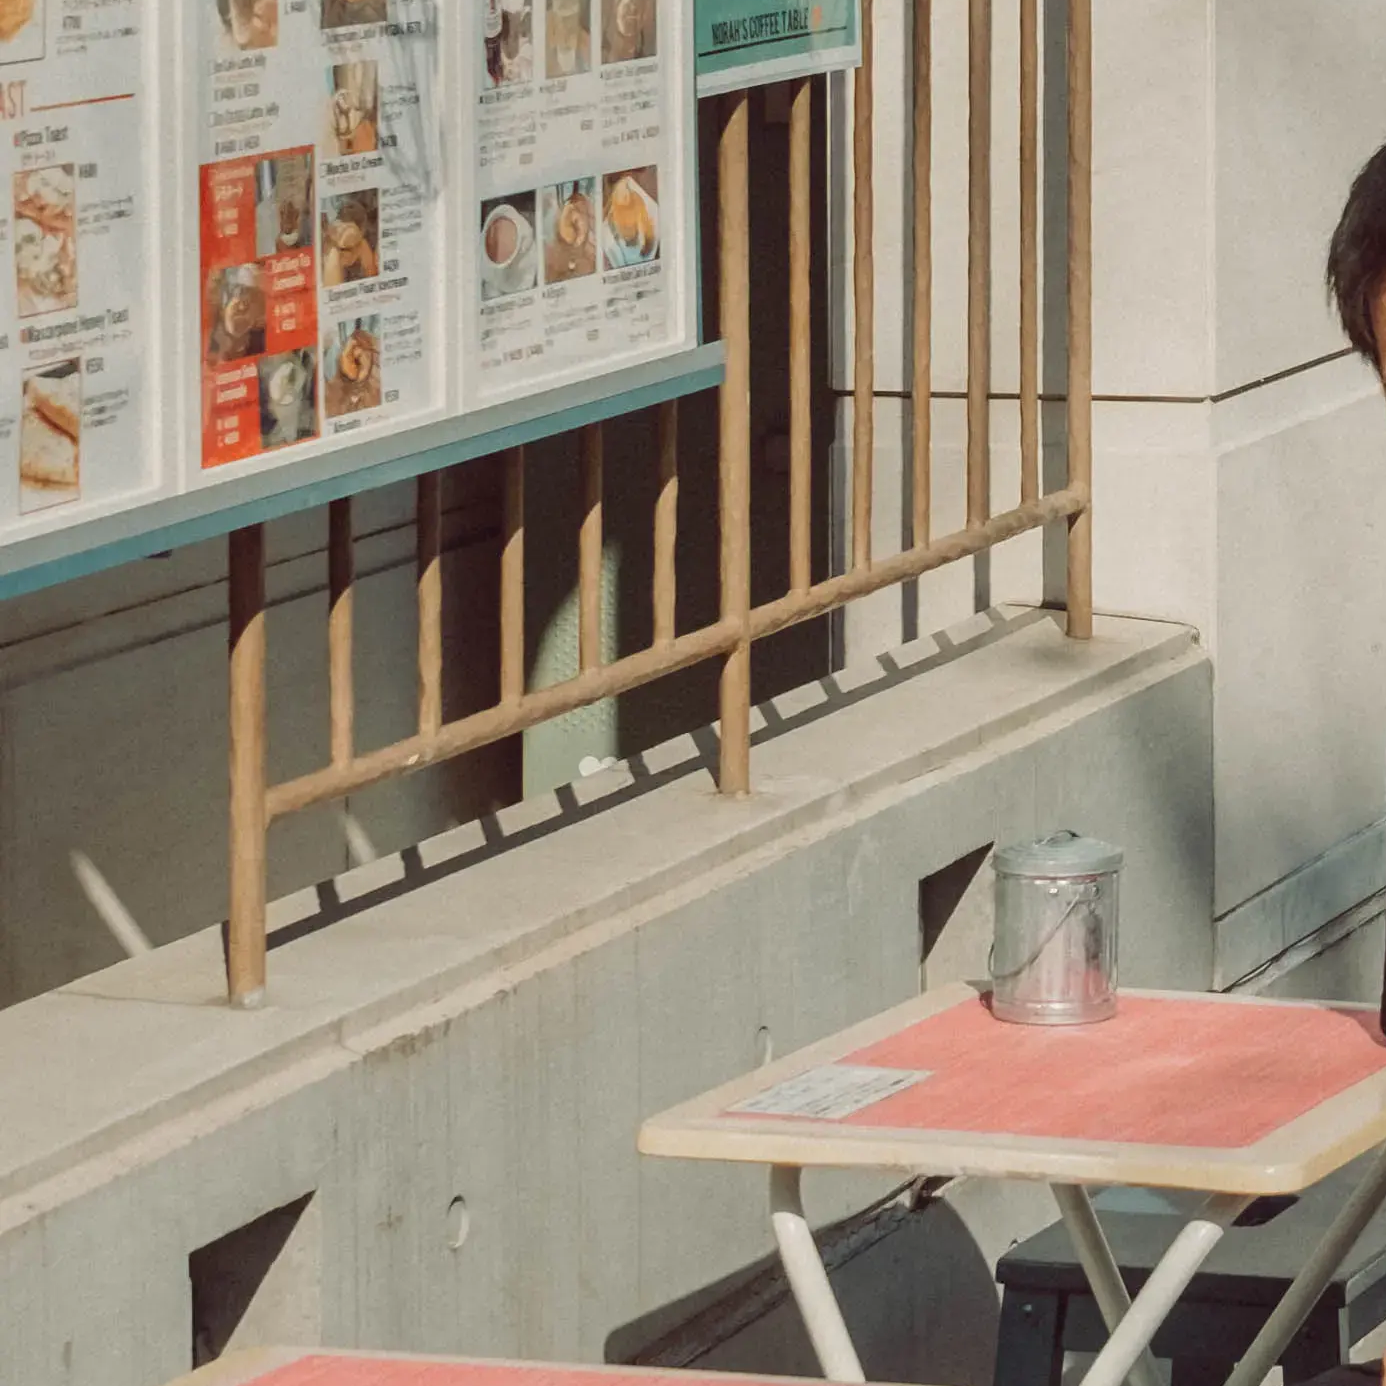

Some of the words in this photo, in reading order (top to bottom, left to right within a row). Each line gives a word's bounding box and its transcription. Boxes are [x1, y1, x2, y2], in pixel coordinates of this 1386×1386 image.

[711, 16, 749, 47] NORAH'S
[750, 11, 780, 41] COFFEE
[781, 7, 810, 35] TABLE
